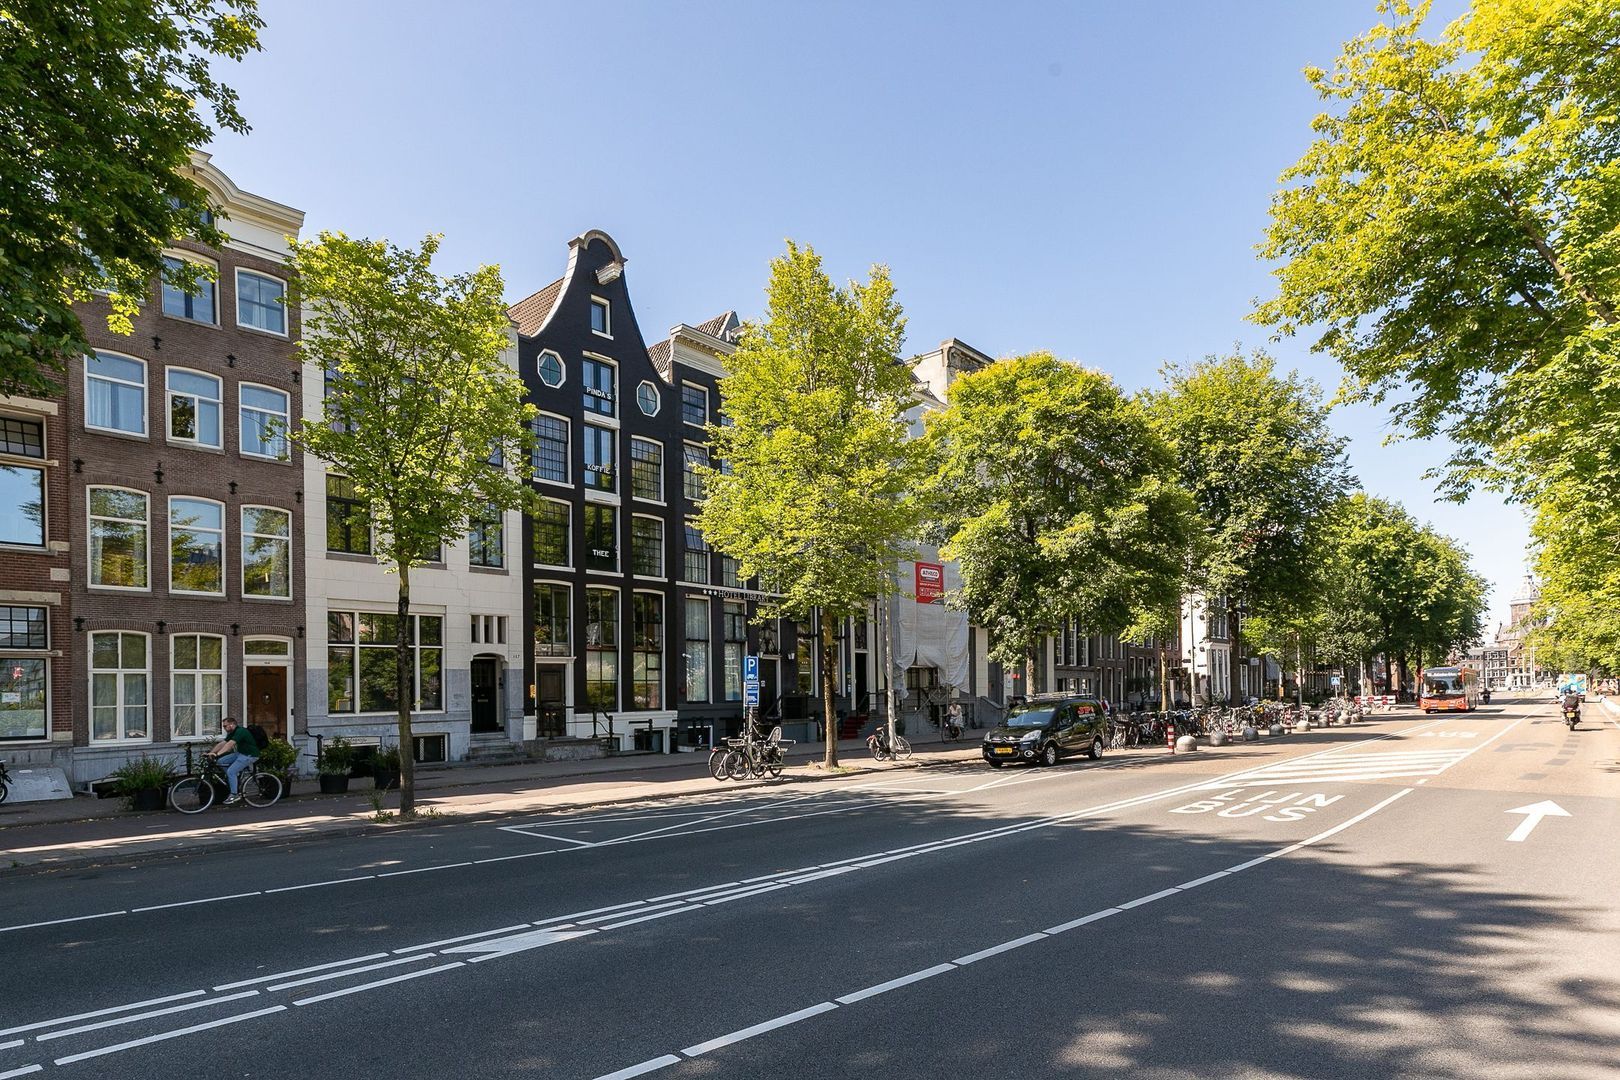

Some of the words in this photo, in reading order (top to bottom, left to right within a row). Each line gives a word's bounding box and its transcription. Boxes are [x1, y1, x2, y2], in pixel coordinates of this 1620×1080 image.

[587, 463, 610, 474] KOFFIE
[592, 549, 610, 558] THEE
[718, 589, 741, 600] HOTEL
[748, 658, 756, 671] P
[1210, 788, 1346, 807] LIJN
[1167, 800, 1317, 822] BUS
